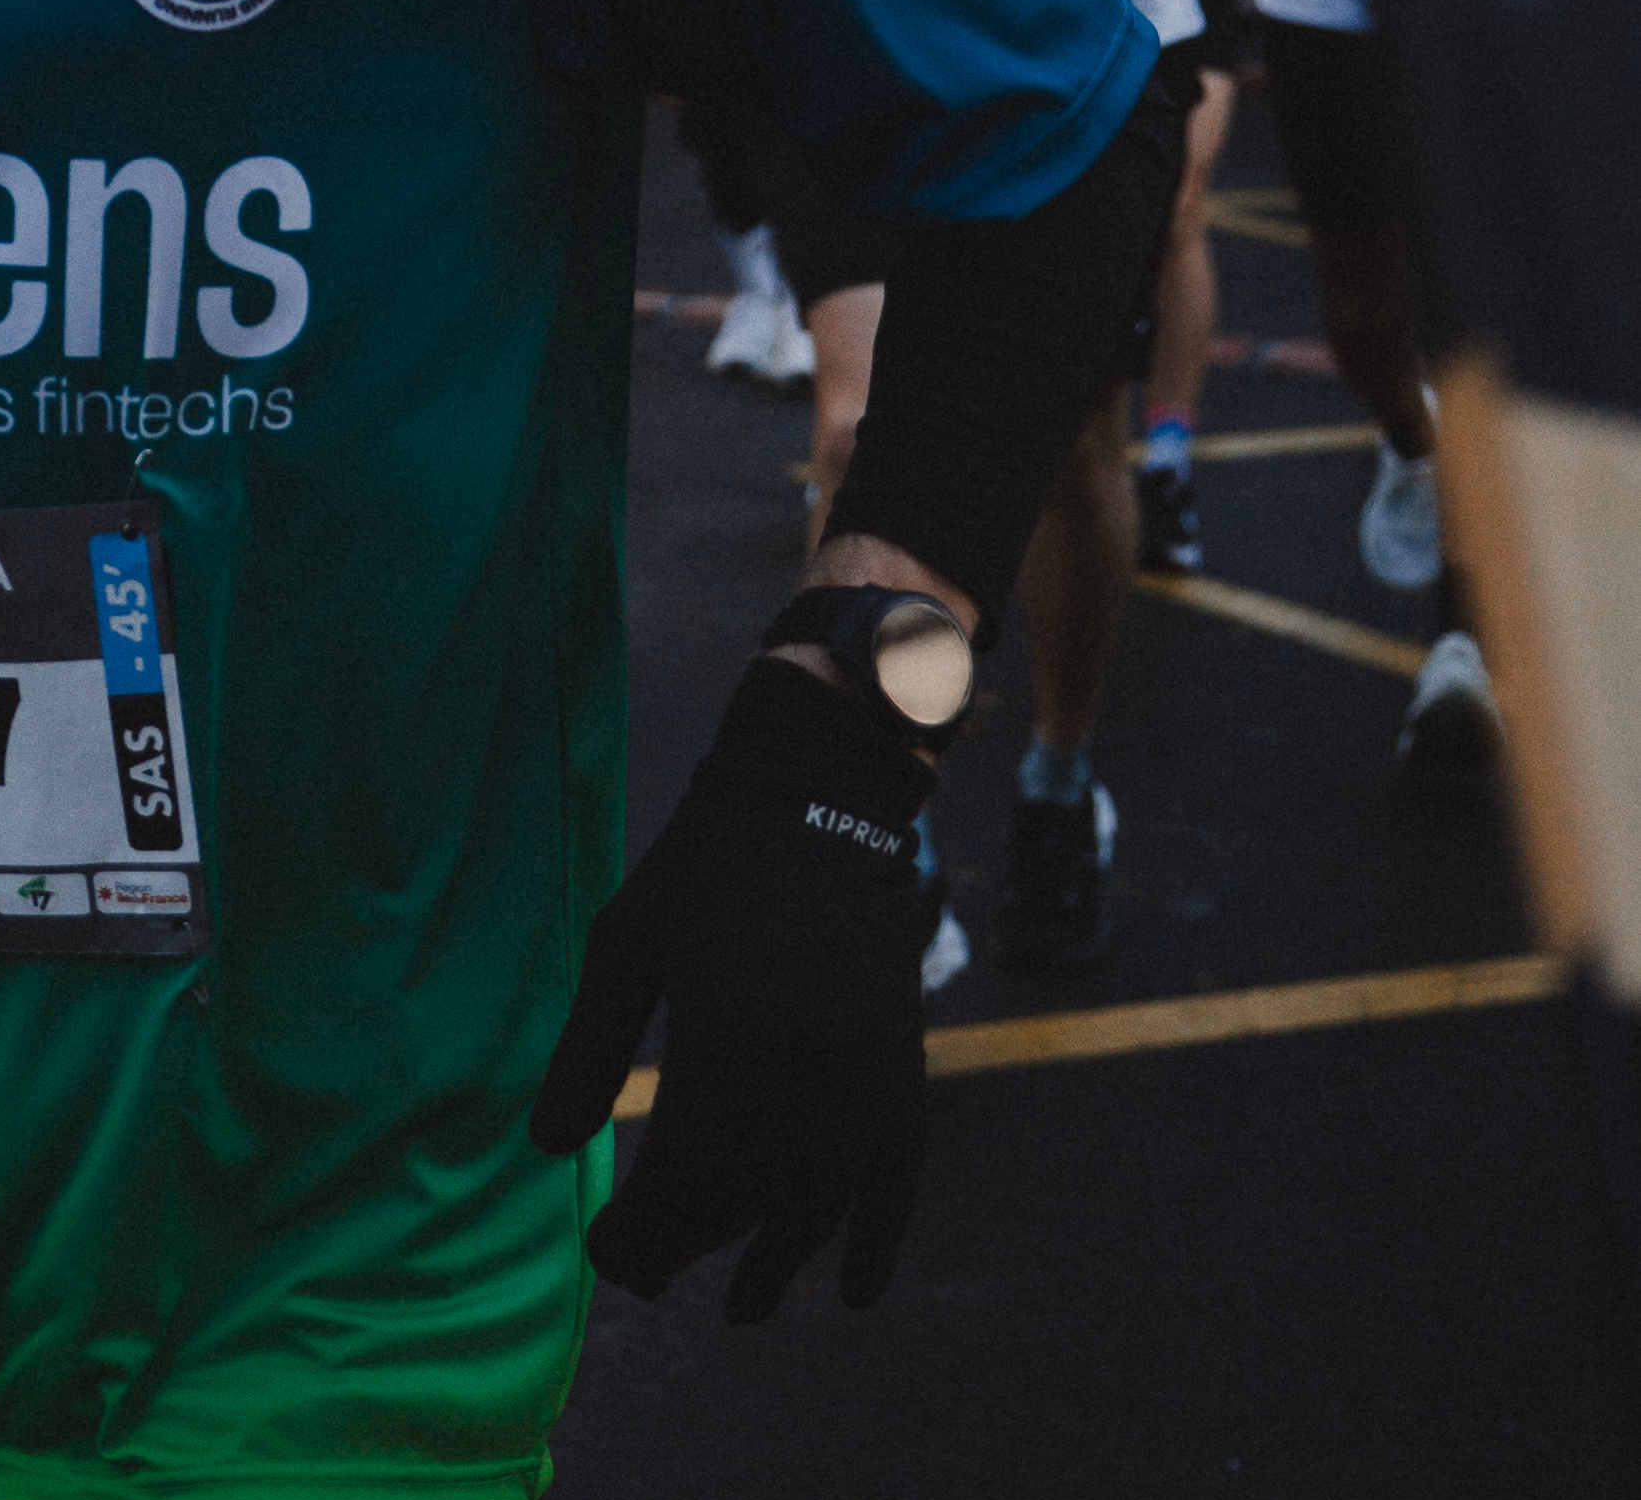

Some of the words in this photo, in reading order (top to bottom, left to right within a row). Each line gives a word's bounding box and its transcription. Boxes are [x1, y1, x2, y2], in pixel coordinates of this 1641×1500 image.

[30, 374, 295, 441] fintechs
[122, 724, 174, 818] SAS
[805, 802, 902, 856] KIPRUN
